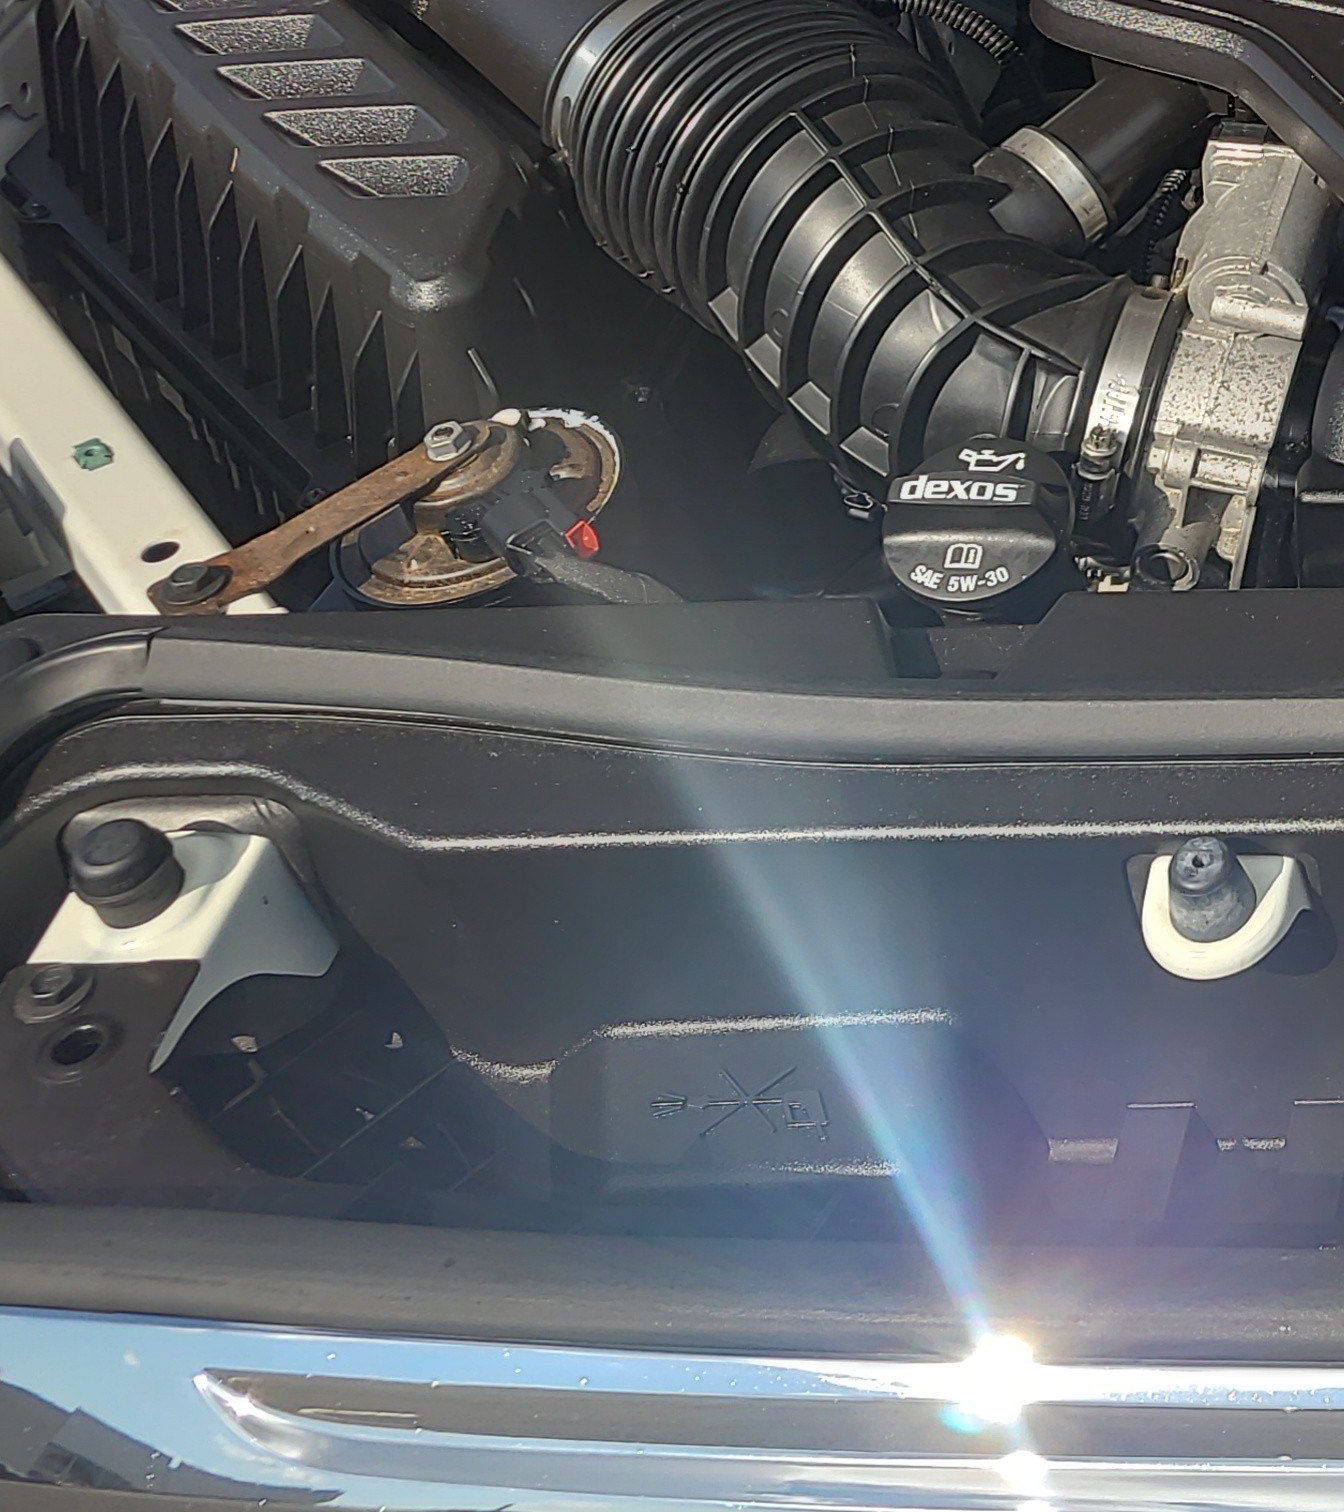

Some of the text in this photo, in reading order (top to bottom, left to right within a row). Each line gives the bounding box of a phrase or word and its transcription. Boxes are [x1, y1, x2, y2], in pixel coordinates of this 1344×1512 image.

[900, 474, 1018, 502] dexos
[910, 564, 1010, 592] SAE 5W-30
